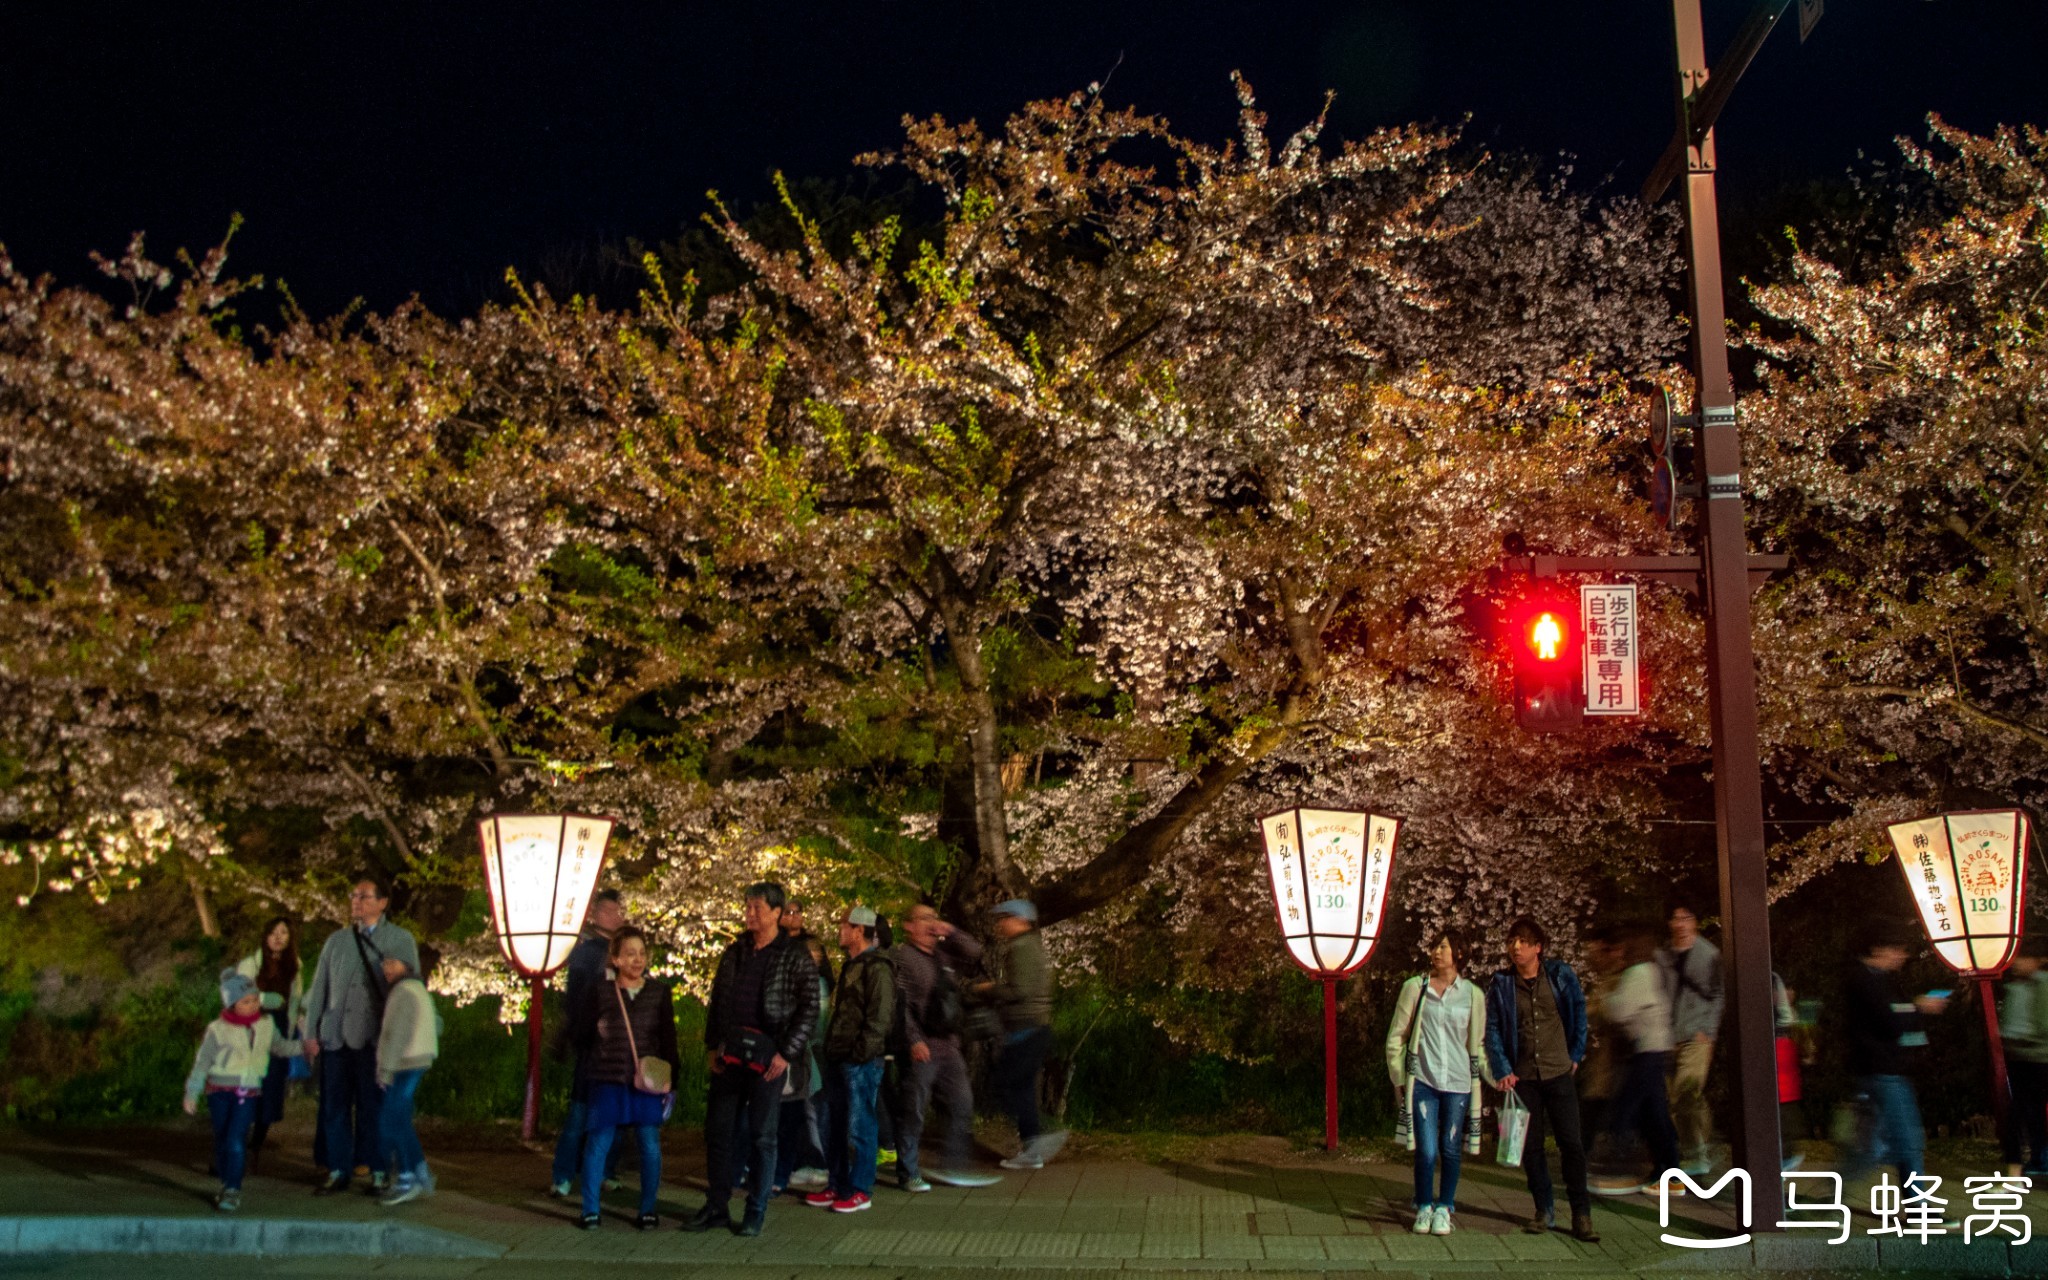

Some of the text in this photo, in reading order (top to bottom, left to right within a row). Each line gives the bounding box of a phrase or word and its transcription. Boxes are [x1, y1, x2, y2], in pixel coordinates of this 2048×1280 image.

[1589, 596, 1608, 657] 自転車
[1610, 596, 1629, 657] 歩行者
[1597, 659, 1623, 708] 専用
[1957, 829, 2009, 844] 弘前さくらまつり
[1960, 849, 2008, 873] HIROSAKI
[1974, 886, 1998, 896] CITY
